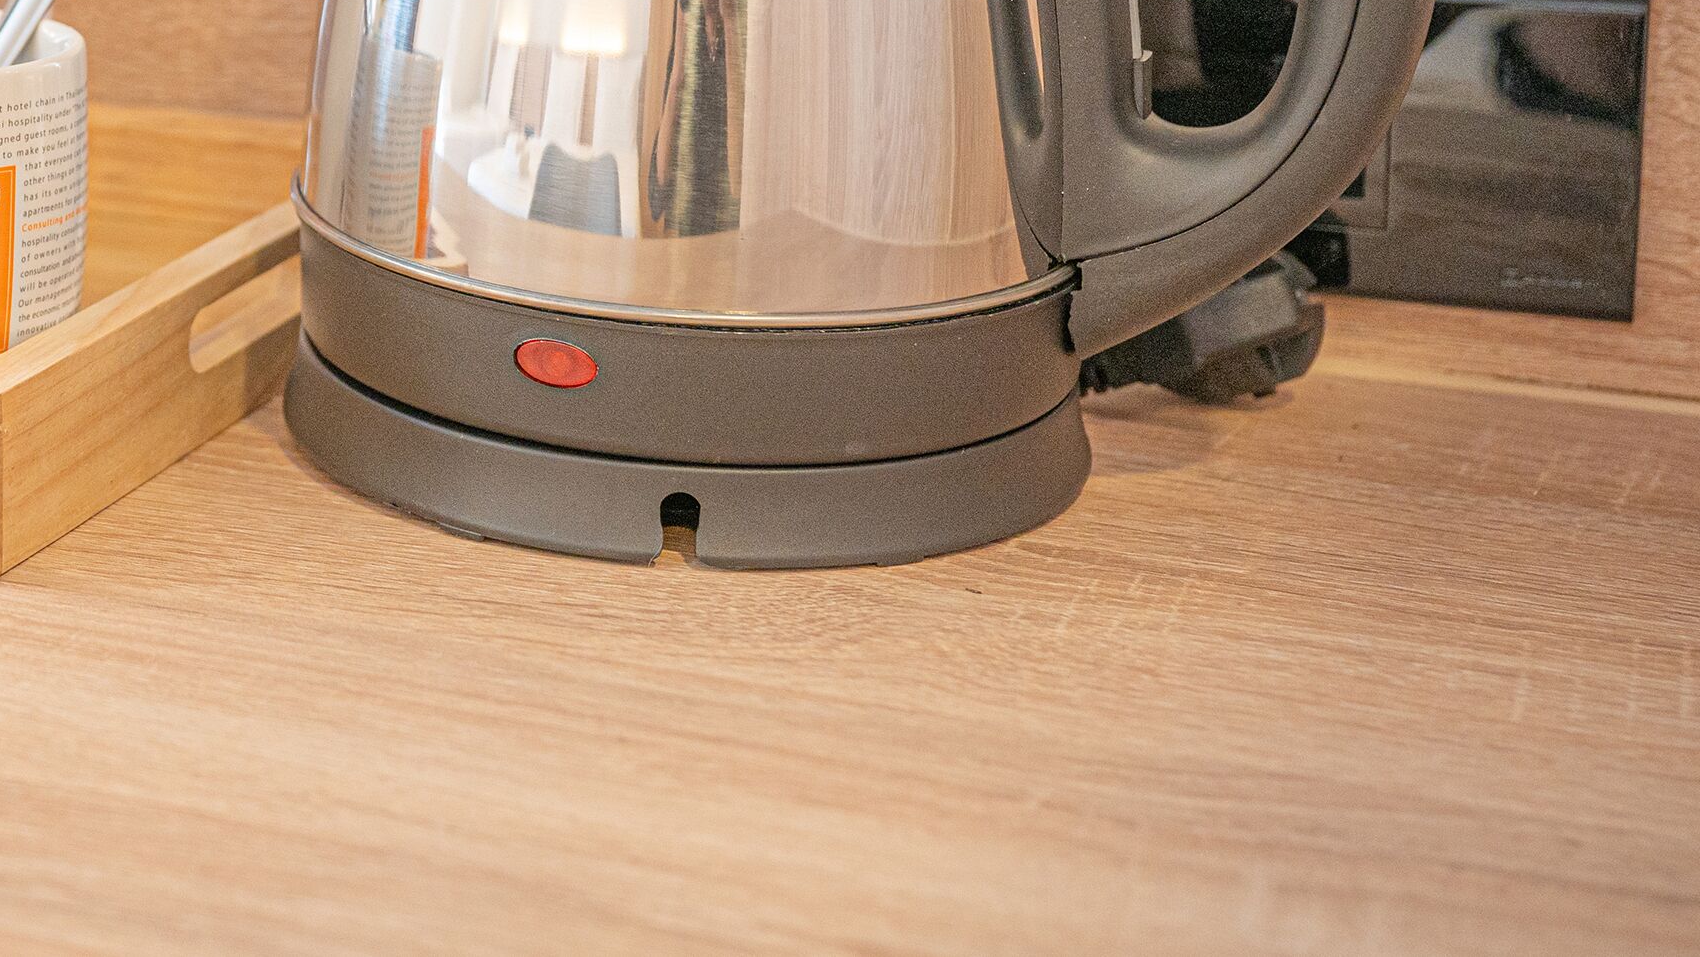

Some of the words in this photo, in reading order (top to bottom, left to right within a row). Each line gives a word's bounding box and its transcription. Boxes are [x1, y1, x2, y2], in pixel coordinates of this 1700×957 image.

[7, 100, 32, 112] hotel
[35, 96, 56, 108] chain
[8, 112, 53, 130] hospitality
[24, 128, 46, 142] guest
[16, 145, 40, 156] make
[25, 162, 42, 170] that
[44, 153, 72, 168] everyone
[24, 176, 46, 186] other
[48, 170, 67, 182] things
[24, 193, 38, 202] has
[42, 190, 52, 198] its
[54, 185, 68, 194] own
[23, 202, 64, 218] apartments
[22, 216, 63, 232] Consulting
[22, 232, 60, 248] hospitality
[21, 253, 30, 264] of
[34, 248, 61, 260] owners
[20, 261, 60, 278] consultation
[20, 282, 35, 292] will
[38, 280, 48, 288] be
[50, 268, 75, 285] operated
[18, 298, 33, 308] Our
[35, 285, 72, 302] management
[18, 313, 30, 322] the
[17, 320, 57, 337] innovative
